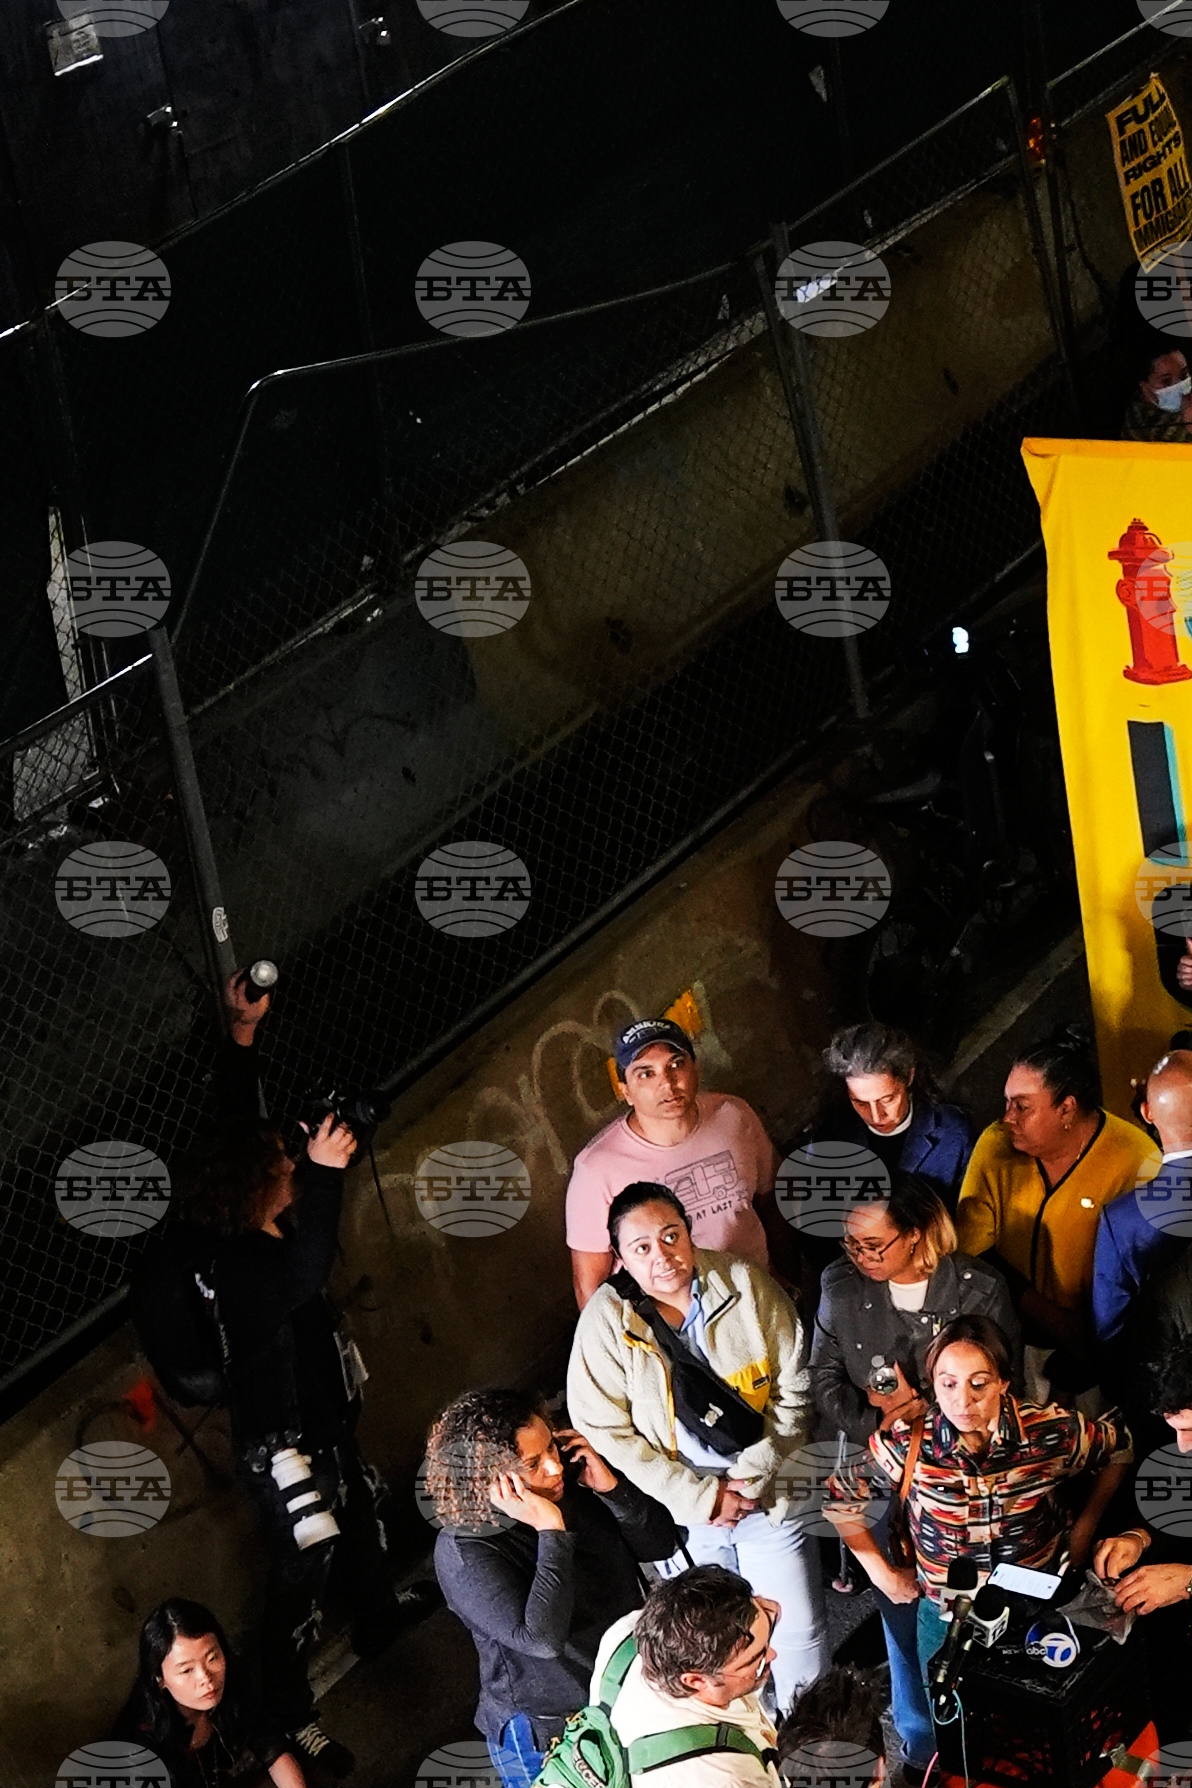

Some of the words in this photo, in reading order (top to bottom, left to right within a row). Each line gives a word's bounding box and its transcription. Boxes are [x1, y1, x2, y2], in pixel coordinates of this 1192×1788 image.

[1116, 87, 1167, 137] FULL
[1119, 129, 1148, 167] AND
[1123, 131, 1181, 185] RIGHTS
[1130, 177, 1168, 228] FOR
[1167, 157, 1190, 205] ALL
[696, 1210, 708, 1221] AT
[1026, 1642, 1047, 1656] abc
